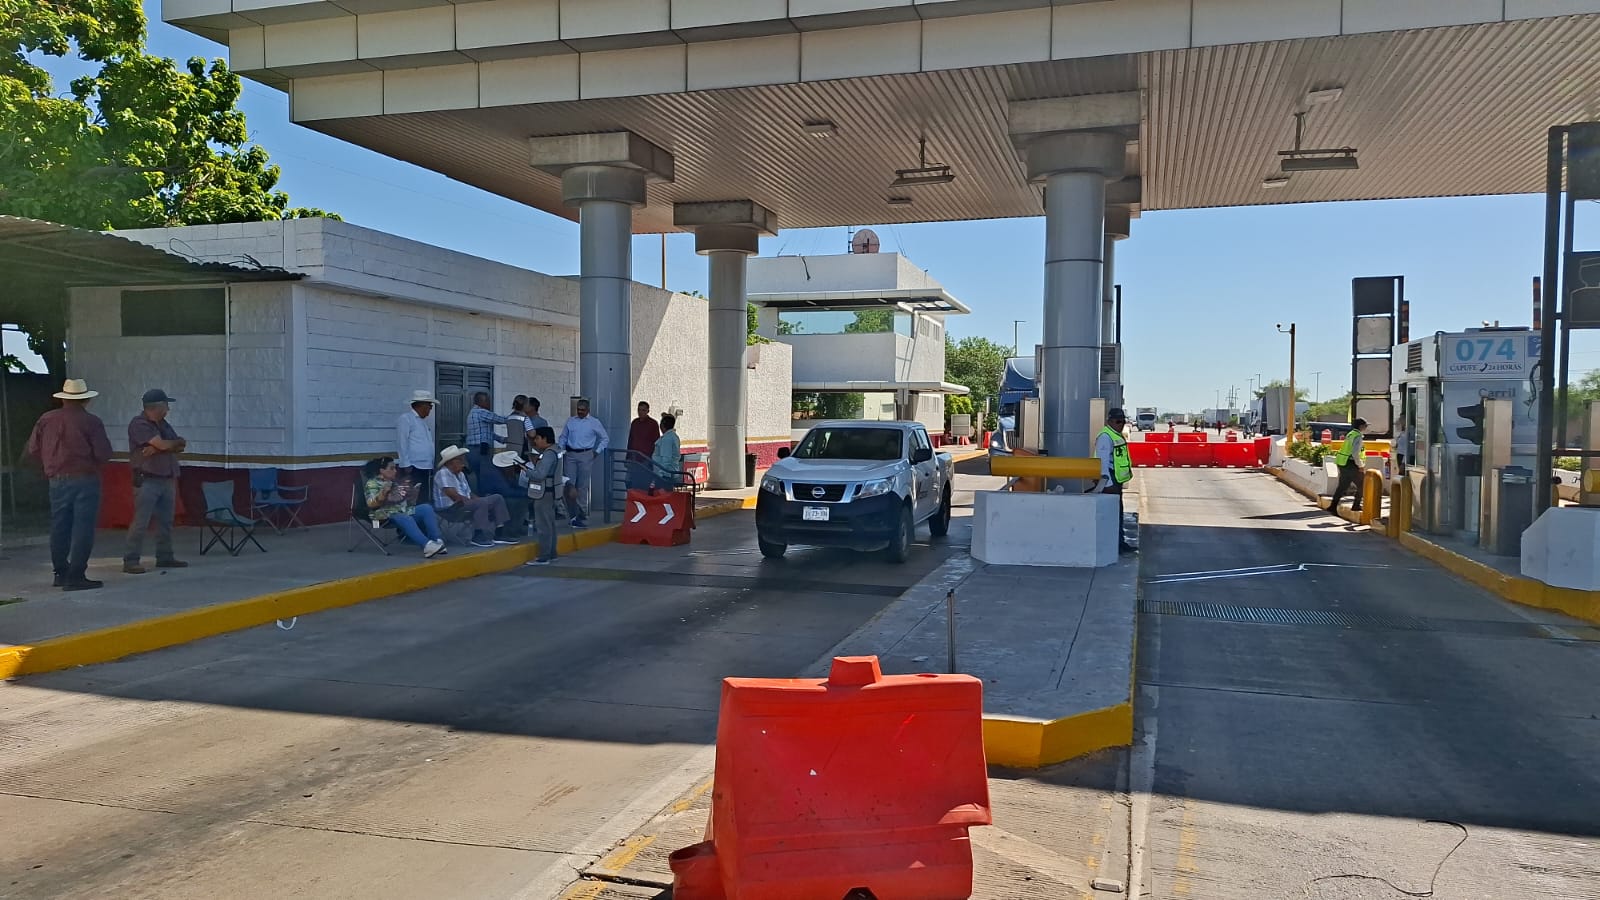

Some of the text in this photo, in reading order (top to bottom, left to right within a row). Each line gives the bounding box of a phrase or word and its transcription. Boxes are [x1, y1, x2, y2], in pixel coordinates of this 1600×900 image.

[1456, 339, 1516, 361] 074
[1449, 364, 1477, 372] CAPUFE
[1497, 363, 1522, 371] HORAS
[1478, 387, 1516, 398] Carril
